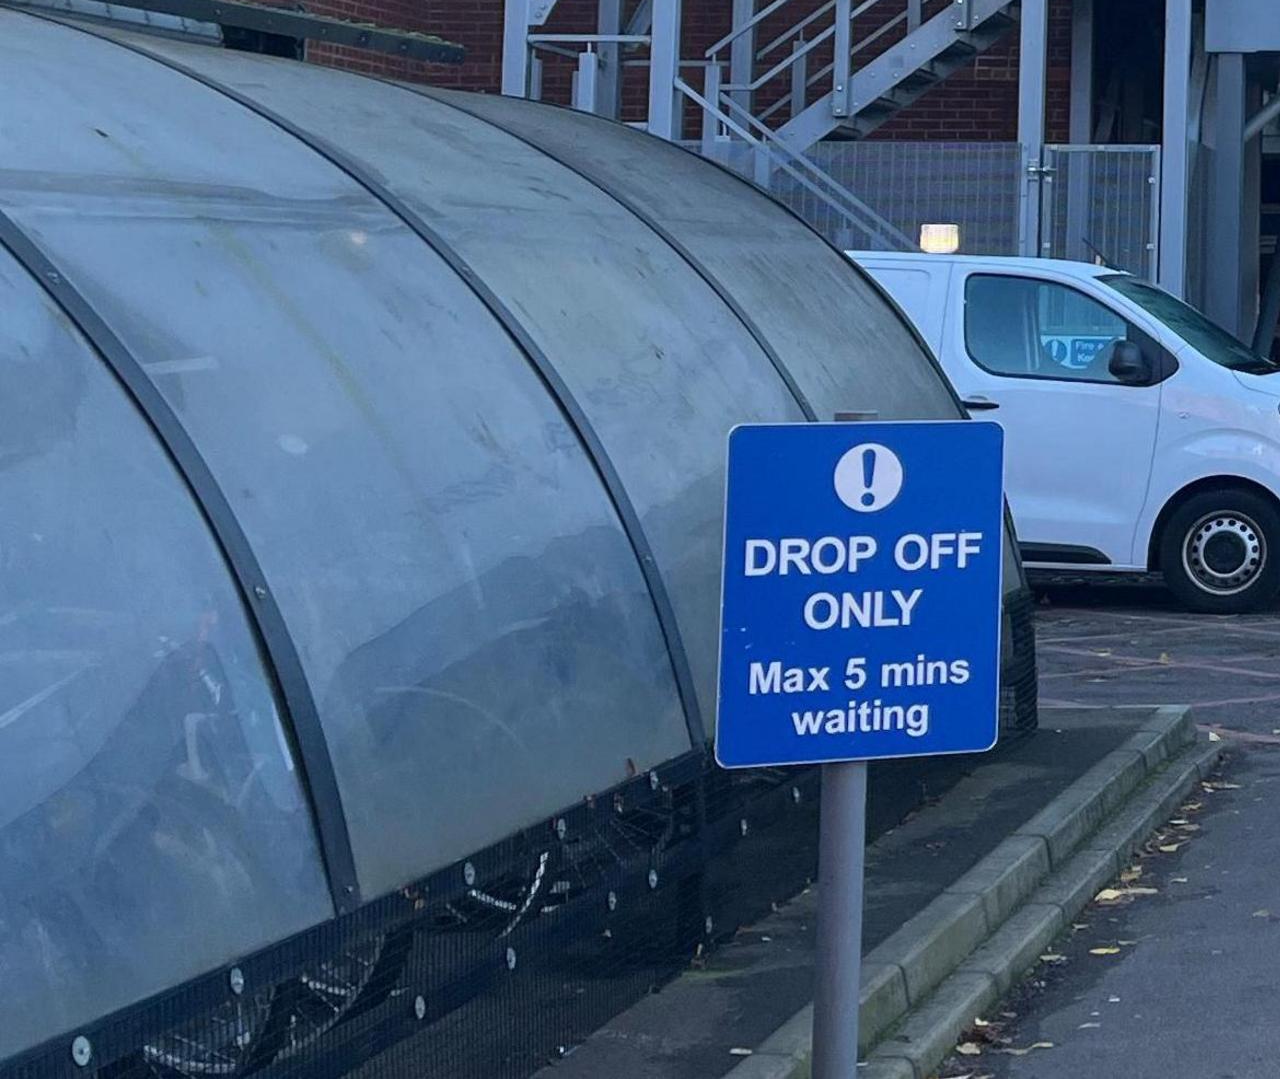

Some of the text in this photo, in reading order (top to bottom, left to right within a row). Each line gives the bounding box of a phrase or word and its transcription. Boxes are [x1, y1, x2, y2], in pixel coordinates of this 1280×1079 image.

[744, 532, 983, 576] DROP OFF
[804, 588, 923, 630] ONLY
[749, 654, 970, 695] Max 5 mins
[792, 700, 929, 737] waiting
